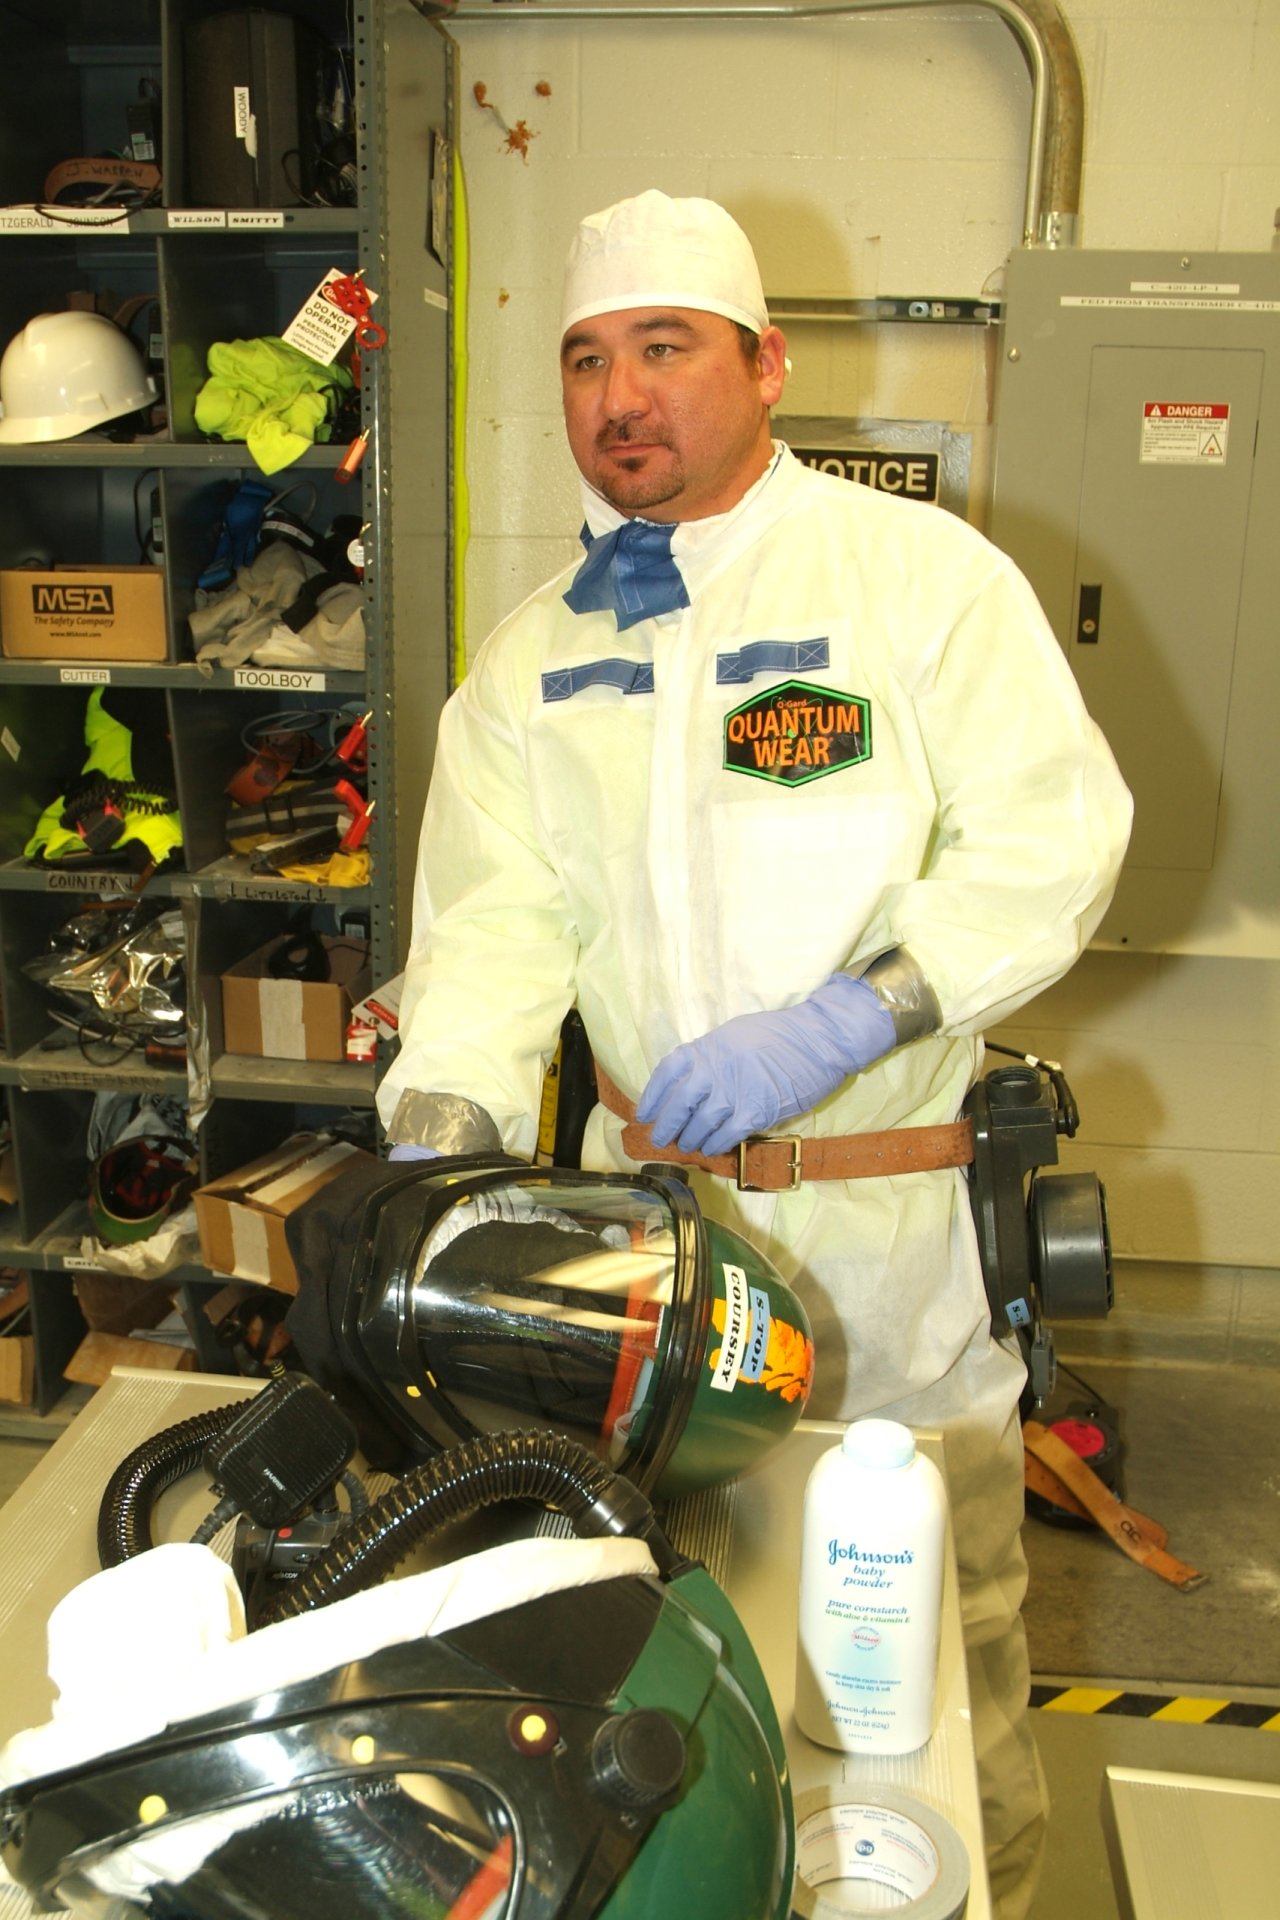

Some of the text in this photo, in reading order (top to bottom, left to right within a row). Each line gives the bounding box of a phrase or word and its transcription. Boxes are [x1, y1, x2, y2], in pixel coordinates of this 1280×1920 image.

[237, 92, 248, 133] WOODY
[313, 301, 351, 326] DO NOT
[1147, 299, 1235, 308] TRANSFORMER
[302, 319, 338, 342] PERSONAL
[305, 307, 350, 337] OPERATE
[296, 322, 337, 349] PROTECTION
[1167, 405, 1213, 417] DANGER
[808, 457, 929, 493] OTICE
[37, 587, 112, 611] MSA
[33, 616, 115, 627] The Safety Company
[62, 670, 108, 681] CUTTER
[237, 671, 313, 688] TOOLBOY
[728, 704, 860, 744] QUANTUM
[753, 735, 831, 768] WEAR
[48, 875, 118, 890] COUNTRY
[721, 1271, 742, 1383] COURSEY
[751, 1296, 764, 1372] S-TOP
[828, 1539, 914, 1565] Johnson's
[843, 1576, 893, 1588] powder
[853, 1564, 886, 1577] baby
[825, 1608, 842, 1617] with
[843, 1612, 860, 1621] aloe
[870, 1615, 903, 1623] vitamin
[827, 1599, 907, 1615] pure cornstarch
